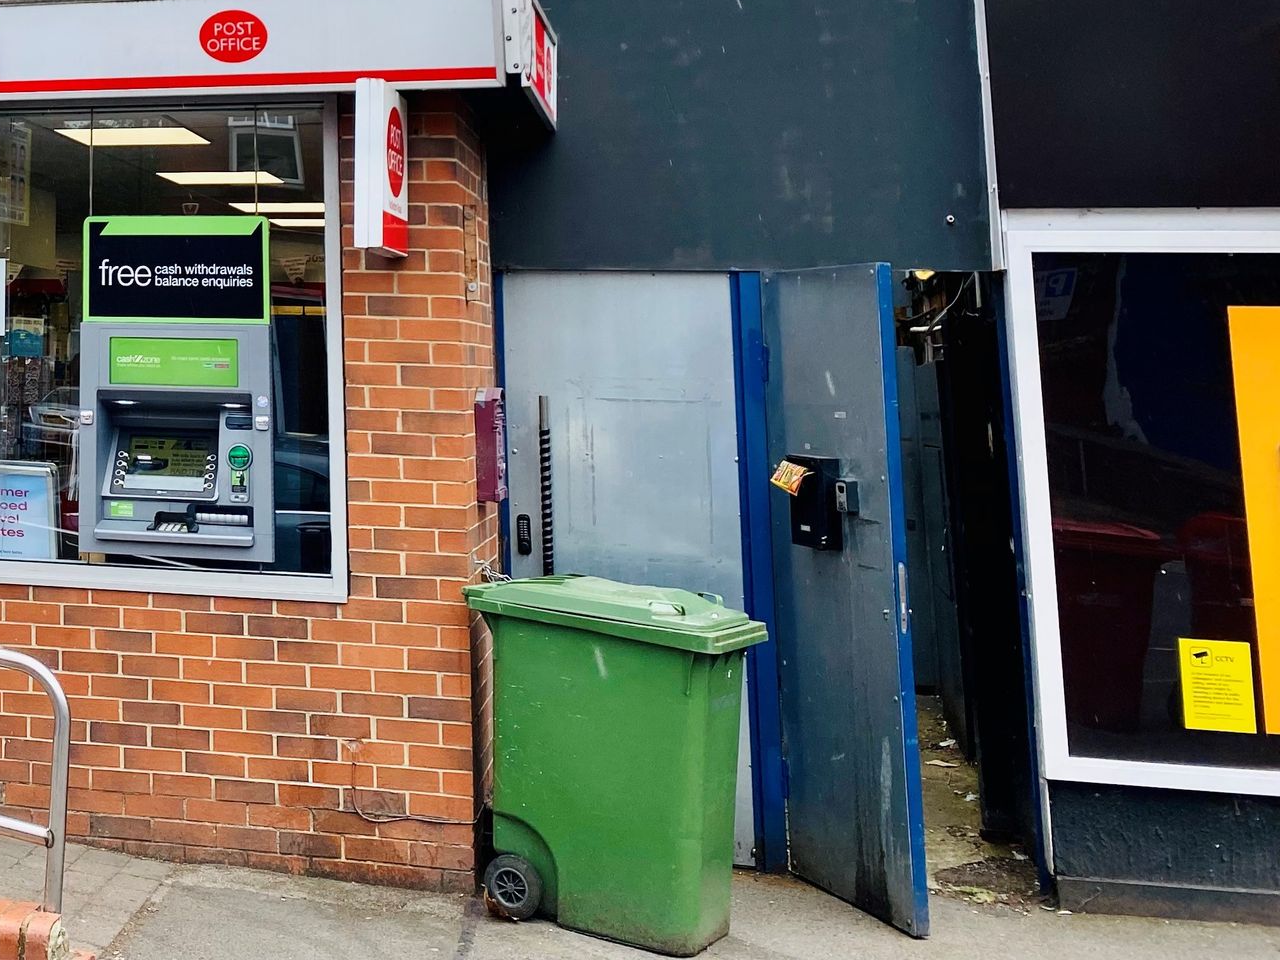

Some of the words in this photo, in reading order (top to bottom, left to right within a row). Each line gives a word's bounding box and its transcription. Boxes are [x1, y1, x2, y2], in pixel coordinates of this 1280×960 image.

[213, 21, 255, 37] POST
[206, 36, 261, 52] OFFICE
[390, 124, 401, 150] POST
[387, 148, 403, 177] OFFICE
[99, 258, 152, 287] free
[154, 264, 182, 275] cash
[184, 264, 253, 275] withdrawals
[154, 276, 199, 287] balance
[201, 276, 253, 289] enquiries
